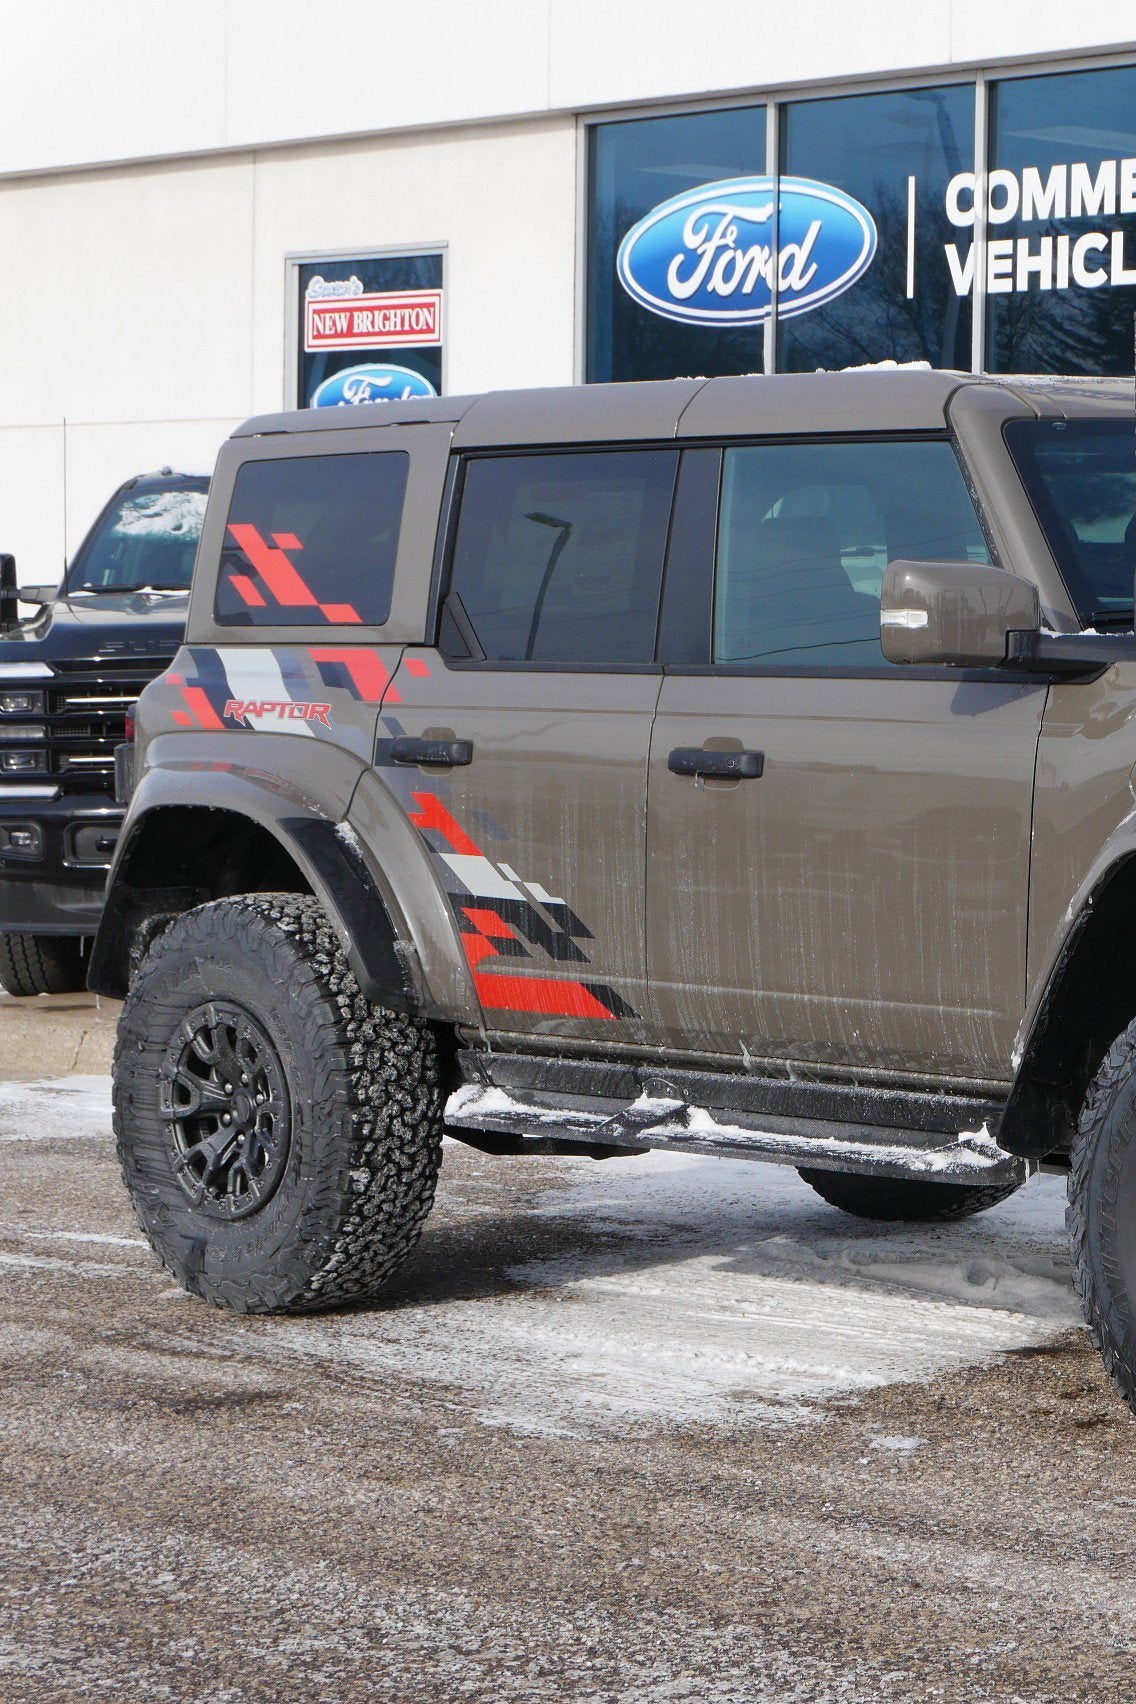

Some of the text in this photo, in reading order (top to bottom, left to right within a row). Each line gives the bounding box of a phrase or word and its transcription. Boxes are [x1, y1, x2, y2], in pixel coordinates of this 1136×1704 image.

[667, 202, 822, 300] Ford
[313, 307, 434, 335] NEW BRIGHTON
[223, 699, 332, 731] RAPTOR
